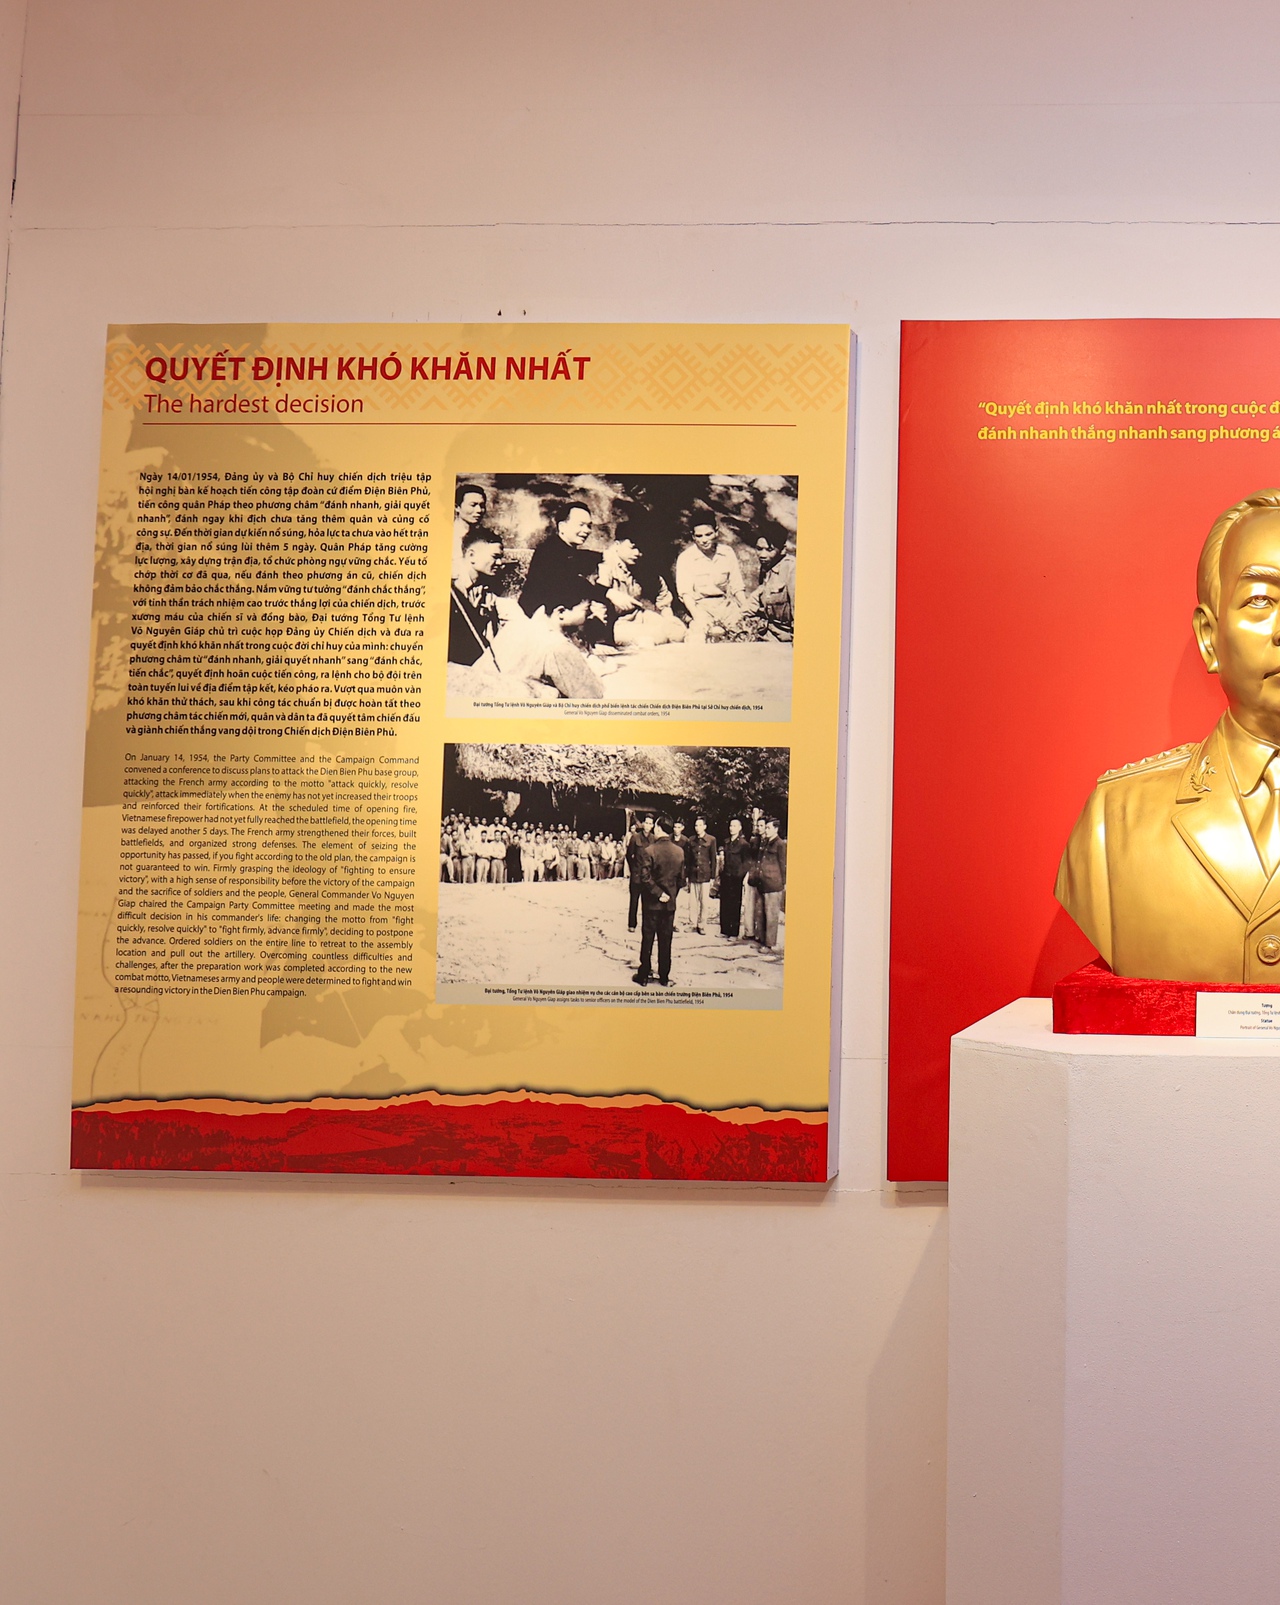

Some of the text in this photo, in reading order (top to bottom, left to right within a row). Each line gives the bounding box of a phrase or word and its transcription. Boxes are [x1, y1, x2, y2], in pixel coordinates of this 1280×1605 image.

[145, 348, 591, 386] QUYẾT ĐỊNH KHÓ KHĂN NHẤT
[144, 393, 363, 413] The hardest decision
[1035, 401, 1069, 418] định
[1073, 401, 1102, 414] khó
[1105, 401, 1143, 414] khăn
[1147, 399, 1182, 414] nhất
[1184, 402, 1227, 417] trong
[1231, 401, 1266, 418] cuộc
[978, 426, 1017, 440] đánh
[1020, 426, 1068, 439] nhanh
[1070, 424, 1116, 443] thắng
[1119, 426, 1168, 439] nhanh
[1170, 429, 1207, 442] sang
[1209, 425, 1270, 442] phương
[140, 471, 432, 483] Ngày 14/01/1954, Đảng ủy và Bộ Chỉ huy chiến dịch triệu tập
[135, 542, 152, 553] địa,
[155, 541, 174, 551] thời
[177, 542, 197, 553] gian
[201, 541, 213, 551] nổ
[216, 542, 238, 553] súng
[256, 542, 280, 551] thêm
[283, 543, 289, 551] 5
[292, 542, 317, 553] ngày.
[320, 542, 345, 552] Quân
[348, 542, 372, 554] Pháp
[375, 543, 396, 554] tăng
[399, 542, 428, 554] cường
[131, 626, 143, 635] Võ
[146, 626, 181, 637] Nguyên
[184, 626, 205, 637] Giáp
[208, 626, 225, 635] chủ
[227, 627, 238, 635] trì
[241, 627, 262, 638] cuộc
[265, 626, 283, 638] họp
[286, 626, 311, 638] Đảng
[313, 626, 325, 638] ủy
[328, 626, 354, 636] Chiến
[357, 627, 377, 639] dịch
[380, 627, 391, 637] và
[394, 627, 412, 637] đưa
[124, 752, 420, 766] On January 14, 1954, the Party Committee and the Campaign Command
[120, 838, 416, 852] battlefields, and organized strong defenses. The element of seizing the
[116, 948, 413, 962] location and pull out the artillery. Overcoming countless difficulties and
